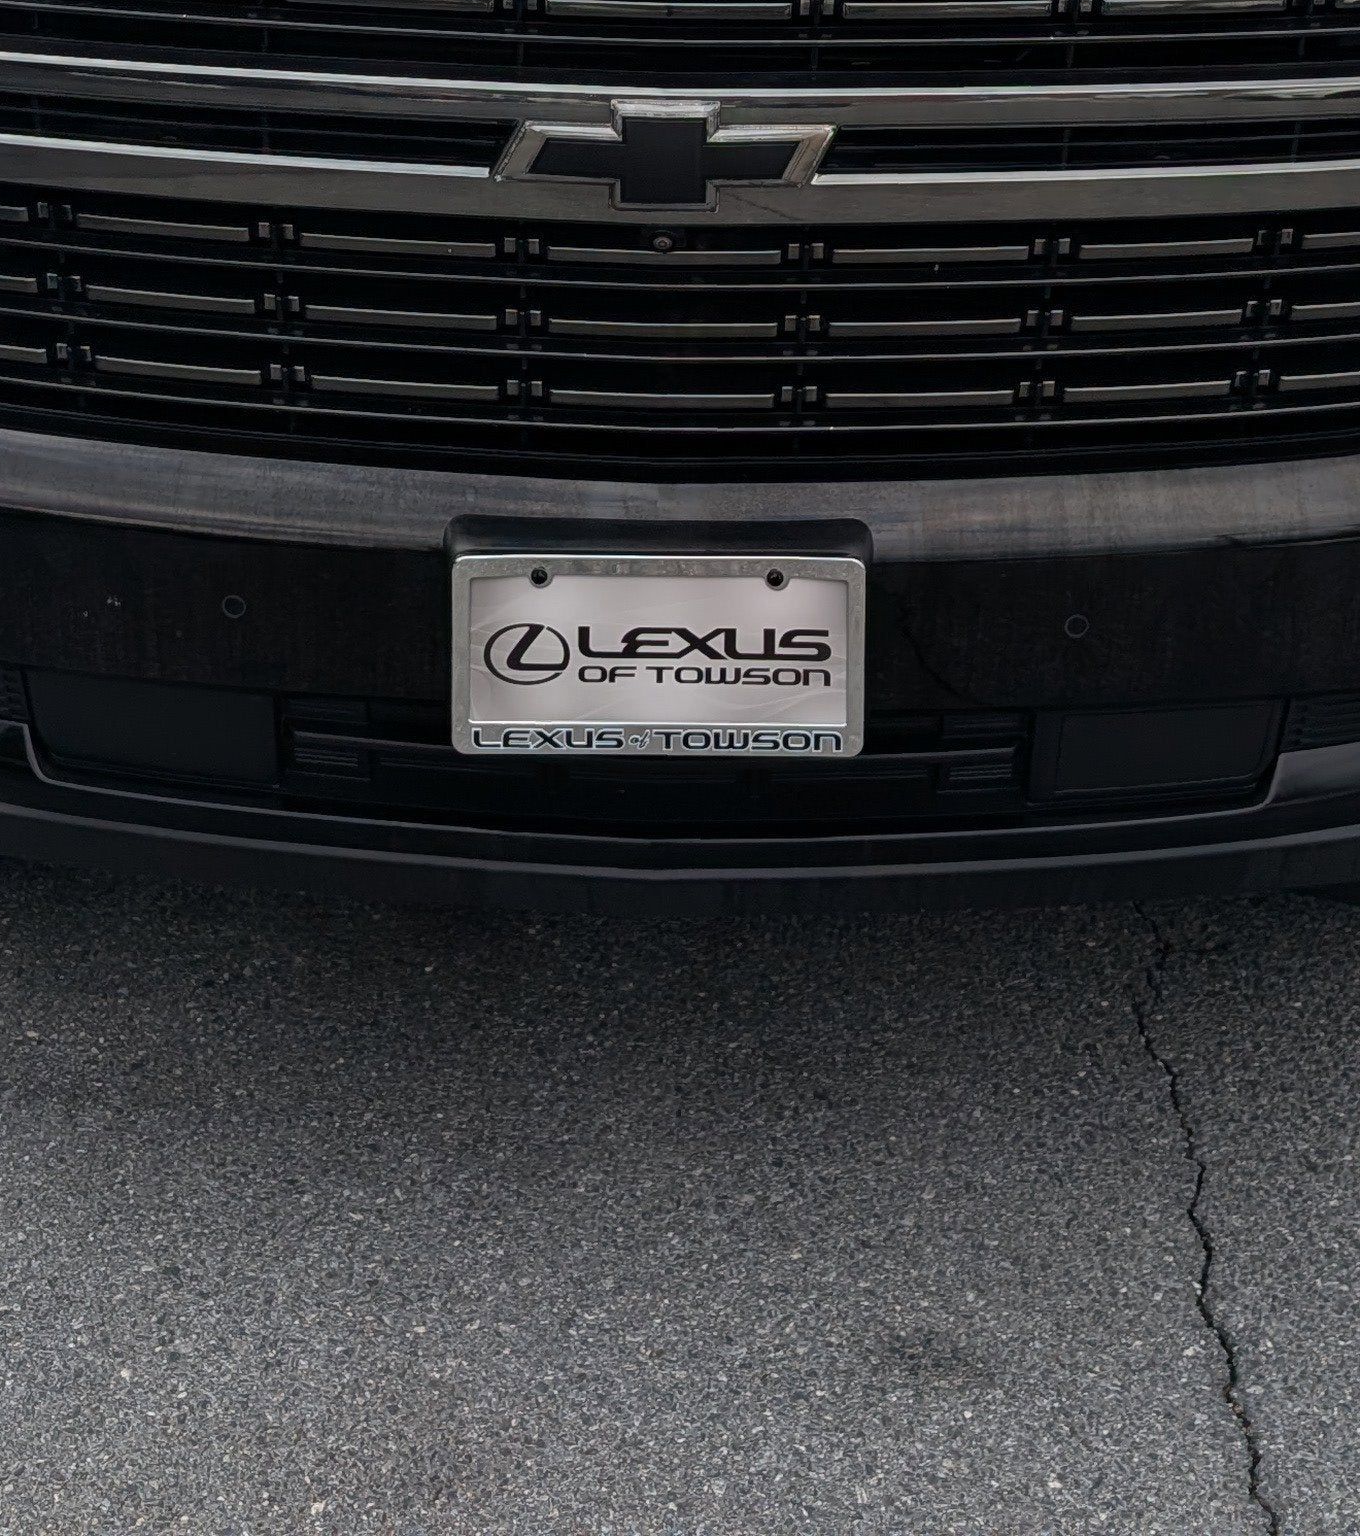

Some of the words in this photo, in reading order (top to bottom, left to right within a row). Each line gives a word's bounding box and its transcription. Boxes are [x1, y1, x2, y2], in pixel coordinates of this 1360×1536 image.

[578, 626, 832, 661] LEXUS
[578, 666, 636, 683] OF
[646, 667, 831, 686] TOWSON
[472, 728, 625, 749] LEXUS
[628, 729, 650, 749] of
[653, 729, 842, 752] TOWSON
